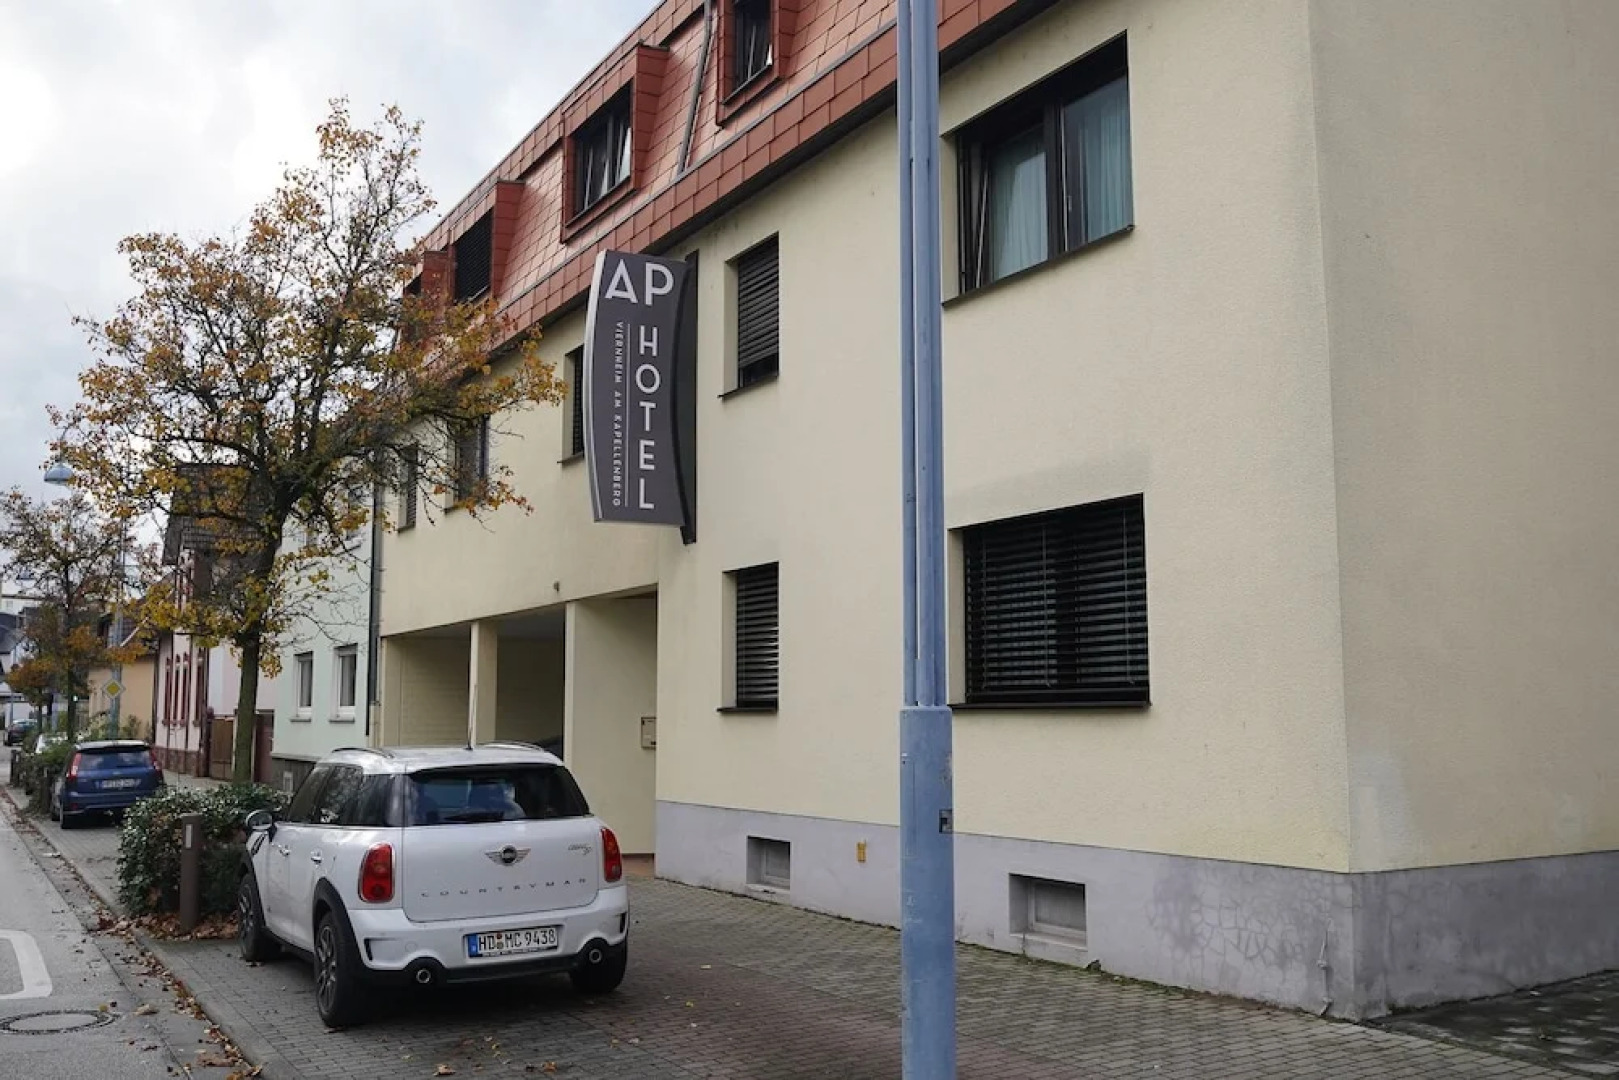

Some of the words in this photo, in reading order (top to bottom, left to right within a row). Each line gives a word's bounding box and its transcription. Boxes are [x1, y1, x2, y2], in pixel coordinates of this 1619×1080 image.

[613, 320, 624, 384] VIERNHEIM
[613, 391, 622, 408] AM
[635, 324, 661, 510] HOTEL
[611, 414, 622, 507] KAPELLENBERG
[478, 935, 495, 951] HD
[504, 932, 522, 948] MC
[524, 928, 556, 946] 9438
